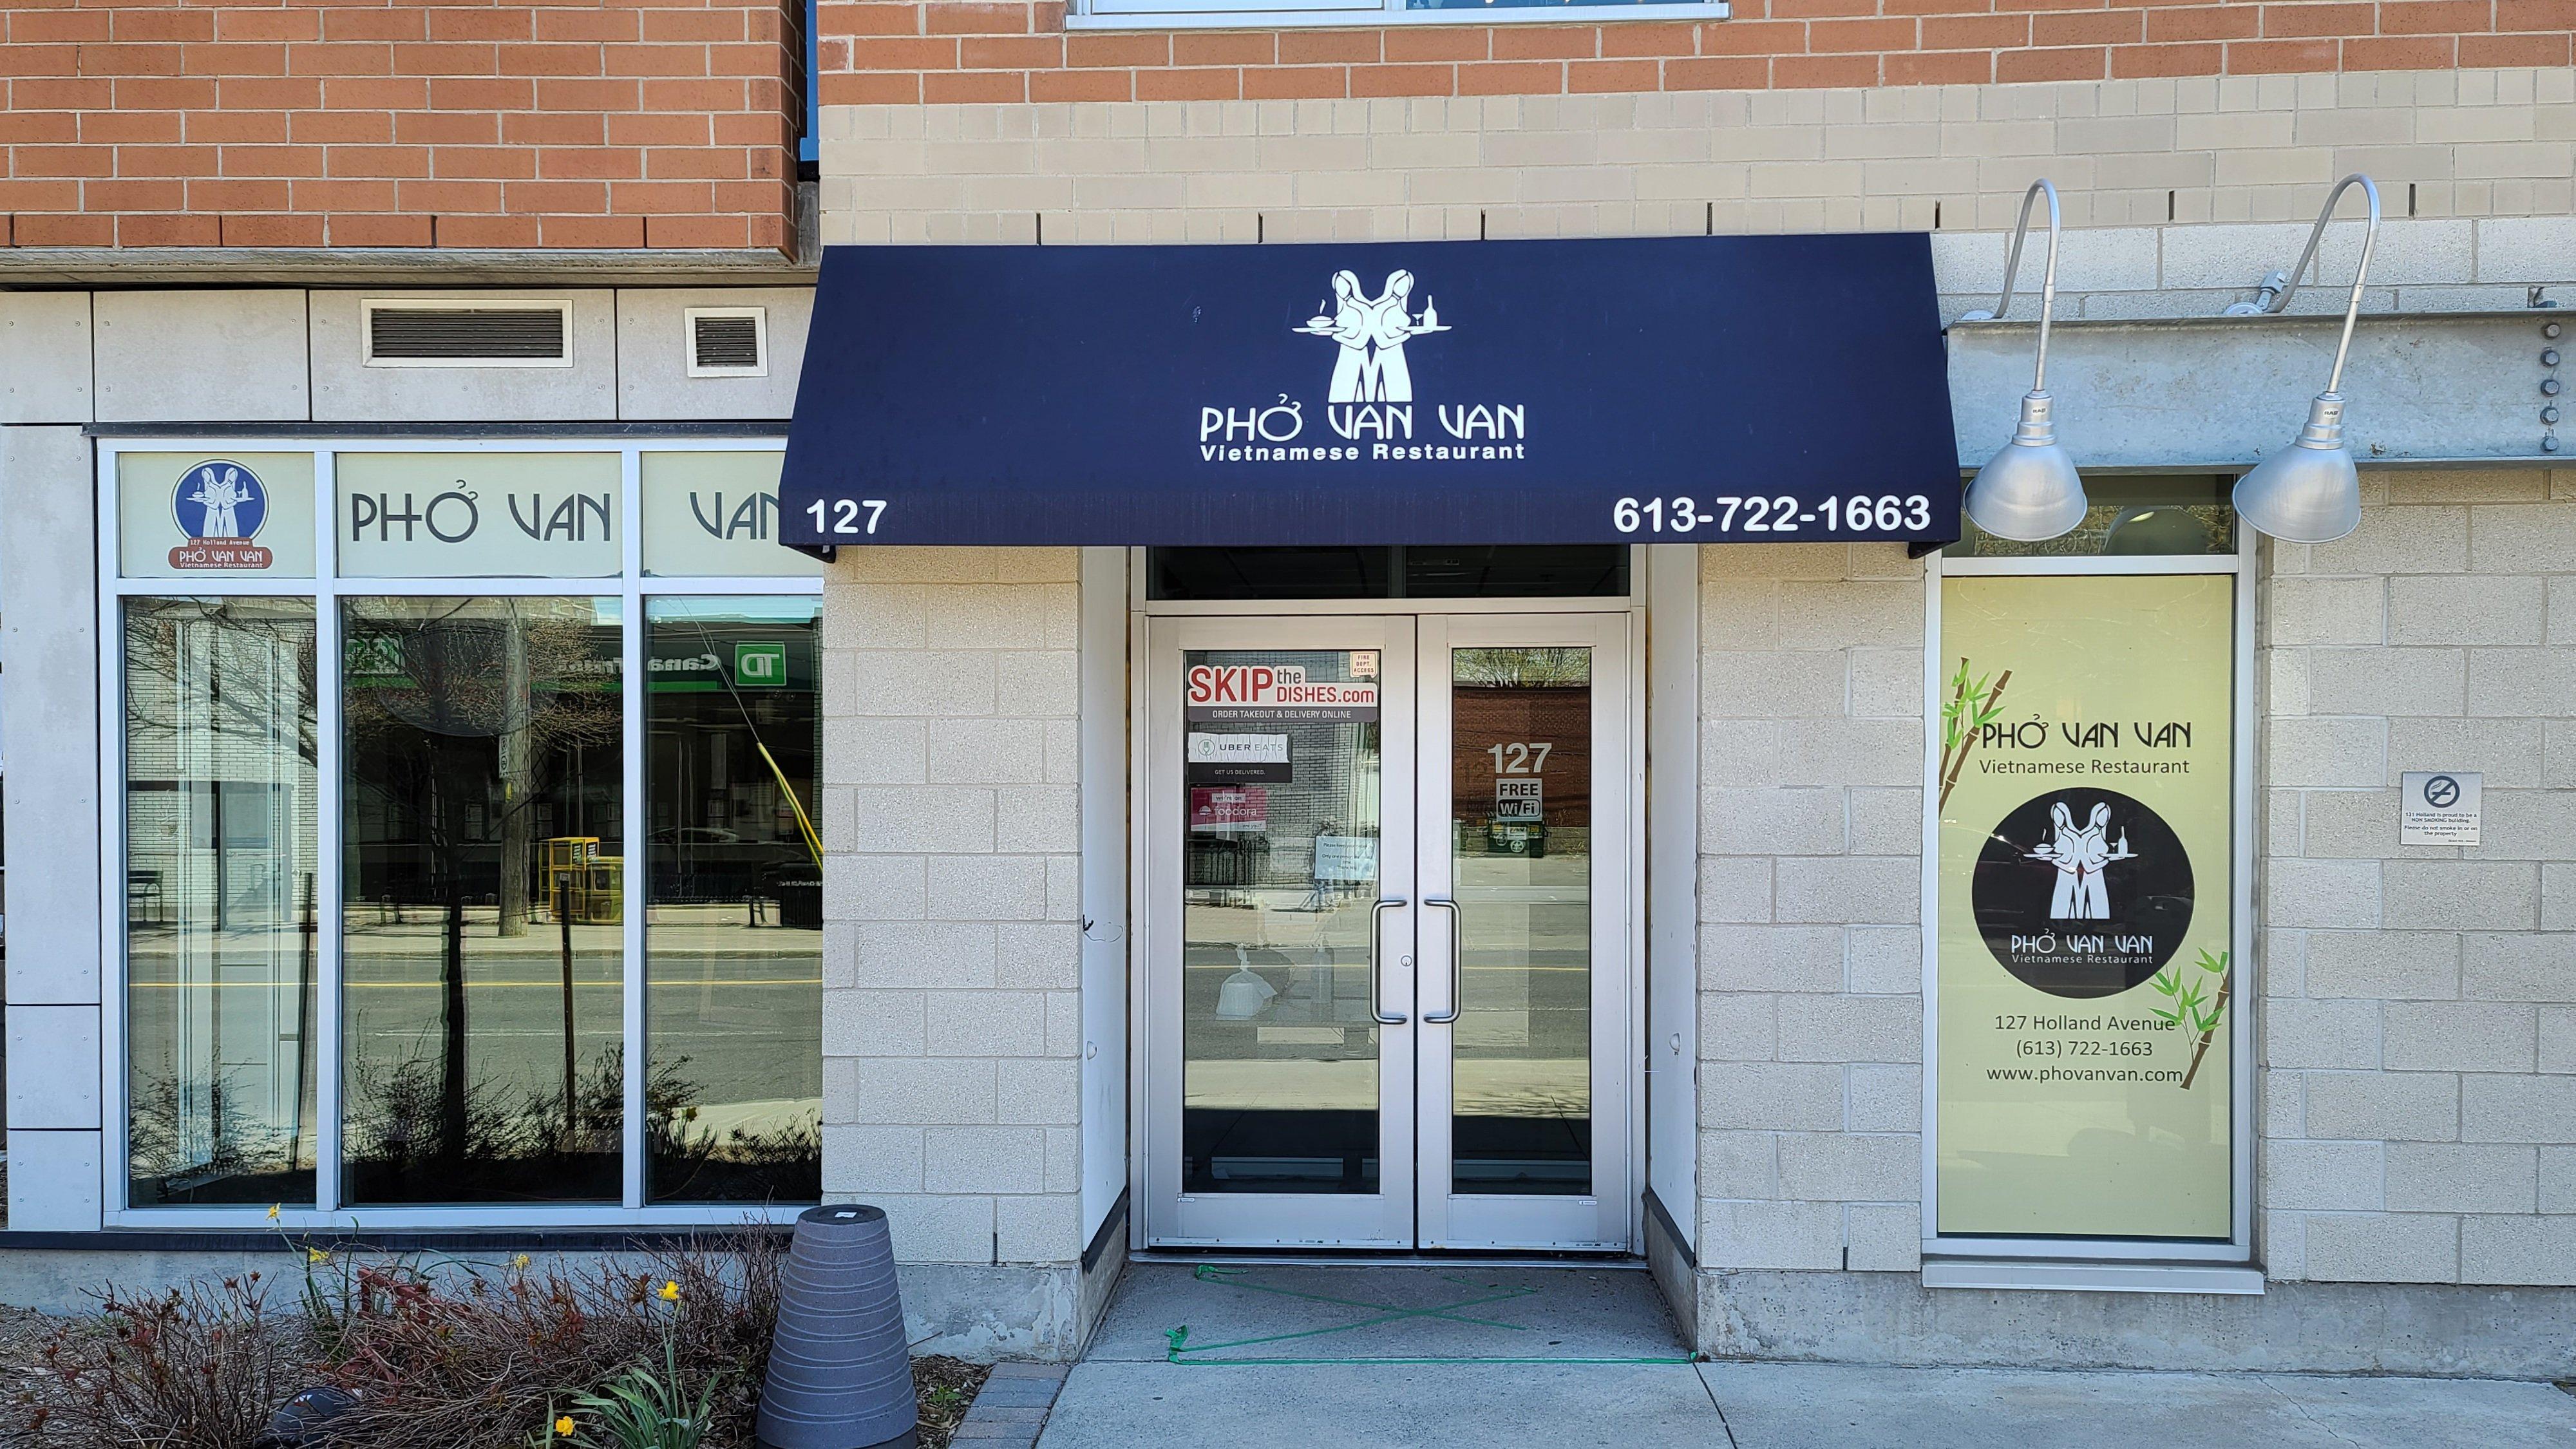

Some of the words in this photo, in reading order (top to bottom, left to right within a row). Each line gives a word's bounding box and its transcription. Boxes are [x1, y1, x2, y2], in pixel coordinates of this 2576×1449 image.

[1327, 404, 1412, 440] VAN
[1438, 404, 1524, 439] VAN
[1200, 444, 1359, 462] Vietnamese
[1372, 443, 1525, 460] Restaurant
[508, 494, 610, 542] VAN
[807, 498, 887, 534] 127
[1613, 495, 1931, 533] 613-722-1663
[211, 551, 234, 562] VAN
[240, 551, 263, 562] VAN
[1191, 668, 1273, 702] SKIP
[1277, 668, 1301, 684] the
[1277, 687, 1374, 703] DISHES.com
[1213, 710, 1238, 719] ORDER
[1240, 710, 1274, 719] TAKEOUT
[1276, 710, 1283, 719] &
[1285, 710, 1320, 719] DELIVERY
[1321, 710, 1351, 719] ONLINE
[2061, 722, 2118, 748] VAN
[2134, 722, 2191, 748] VAN
[1488, 743, 1552, 773] 127
[1979, 759, 2085, 773] Vietnamese
[2092, 759, 2190, 773] Restaurant
[1500, 784, 1538, 795] FREE
[2066, 935, 2104, 953] VAN
[2115, 935, 2153, 954] VAN
[2011, 954, 2083, 963] Vietnamese
[2087, 954, 2153, 964] Restaurant
[1995, 1015, 2027, 1030] 127
[2034, 1015, 2101, 1030] Holland
[2107, 1016, 2176, 1031] Avenue
[2016, 1039, 2062, 1059] (613)
[2068, 1041, 2153, 1056] 722-1663
[1986, 1066, 2183, 1083] www.phovanvan.com
